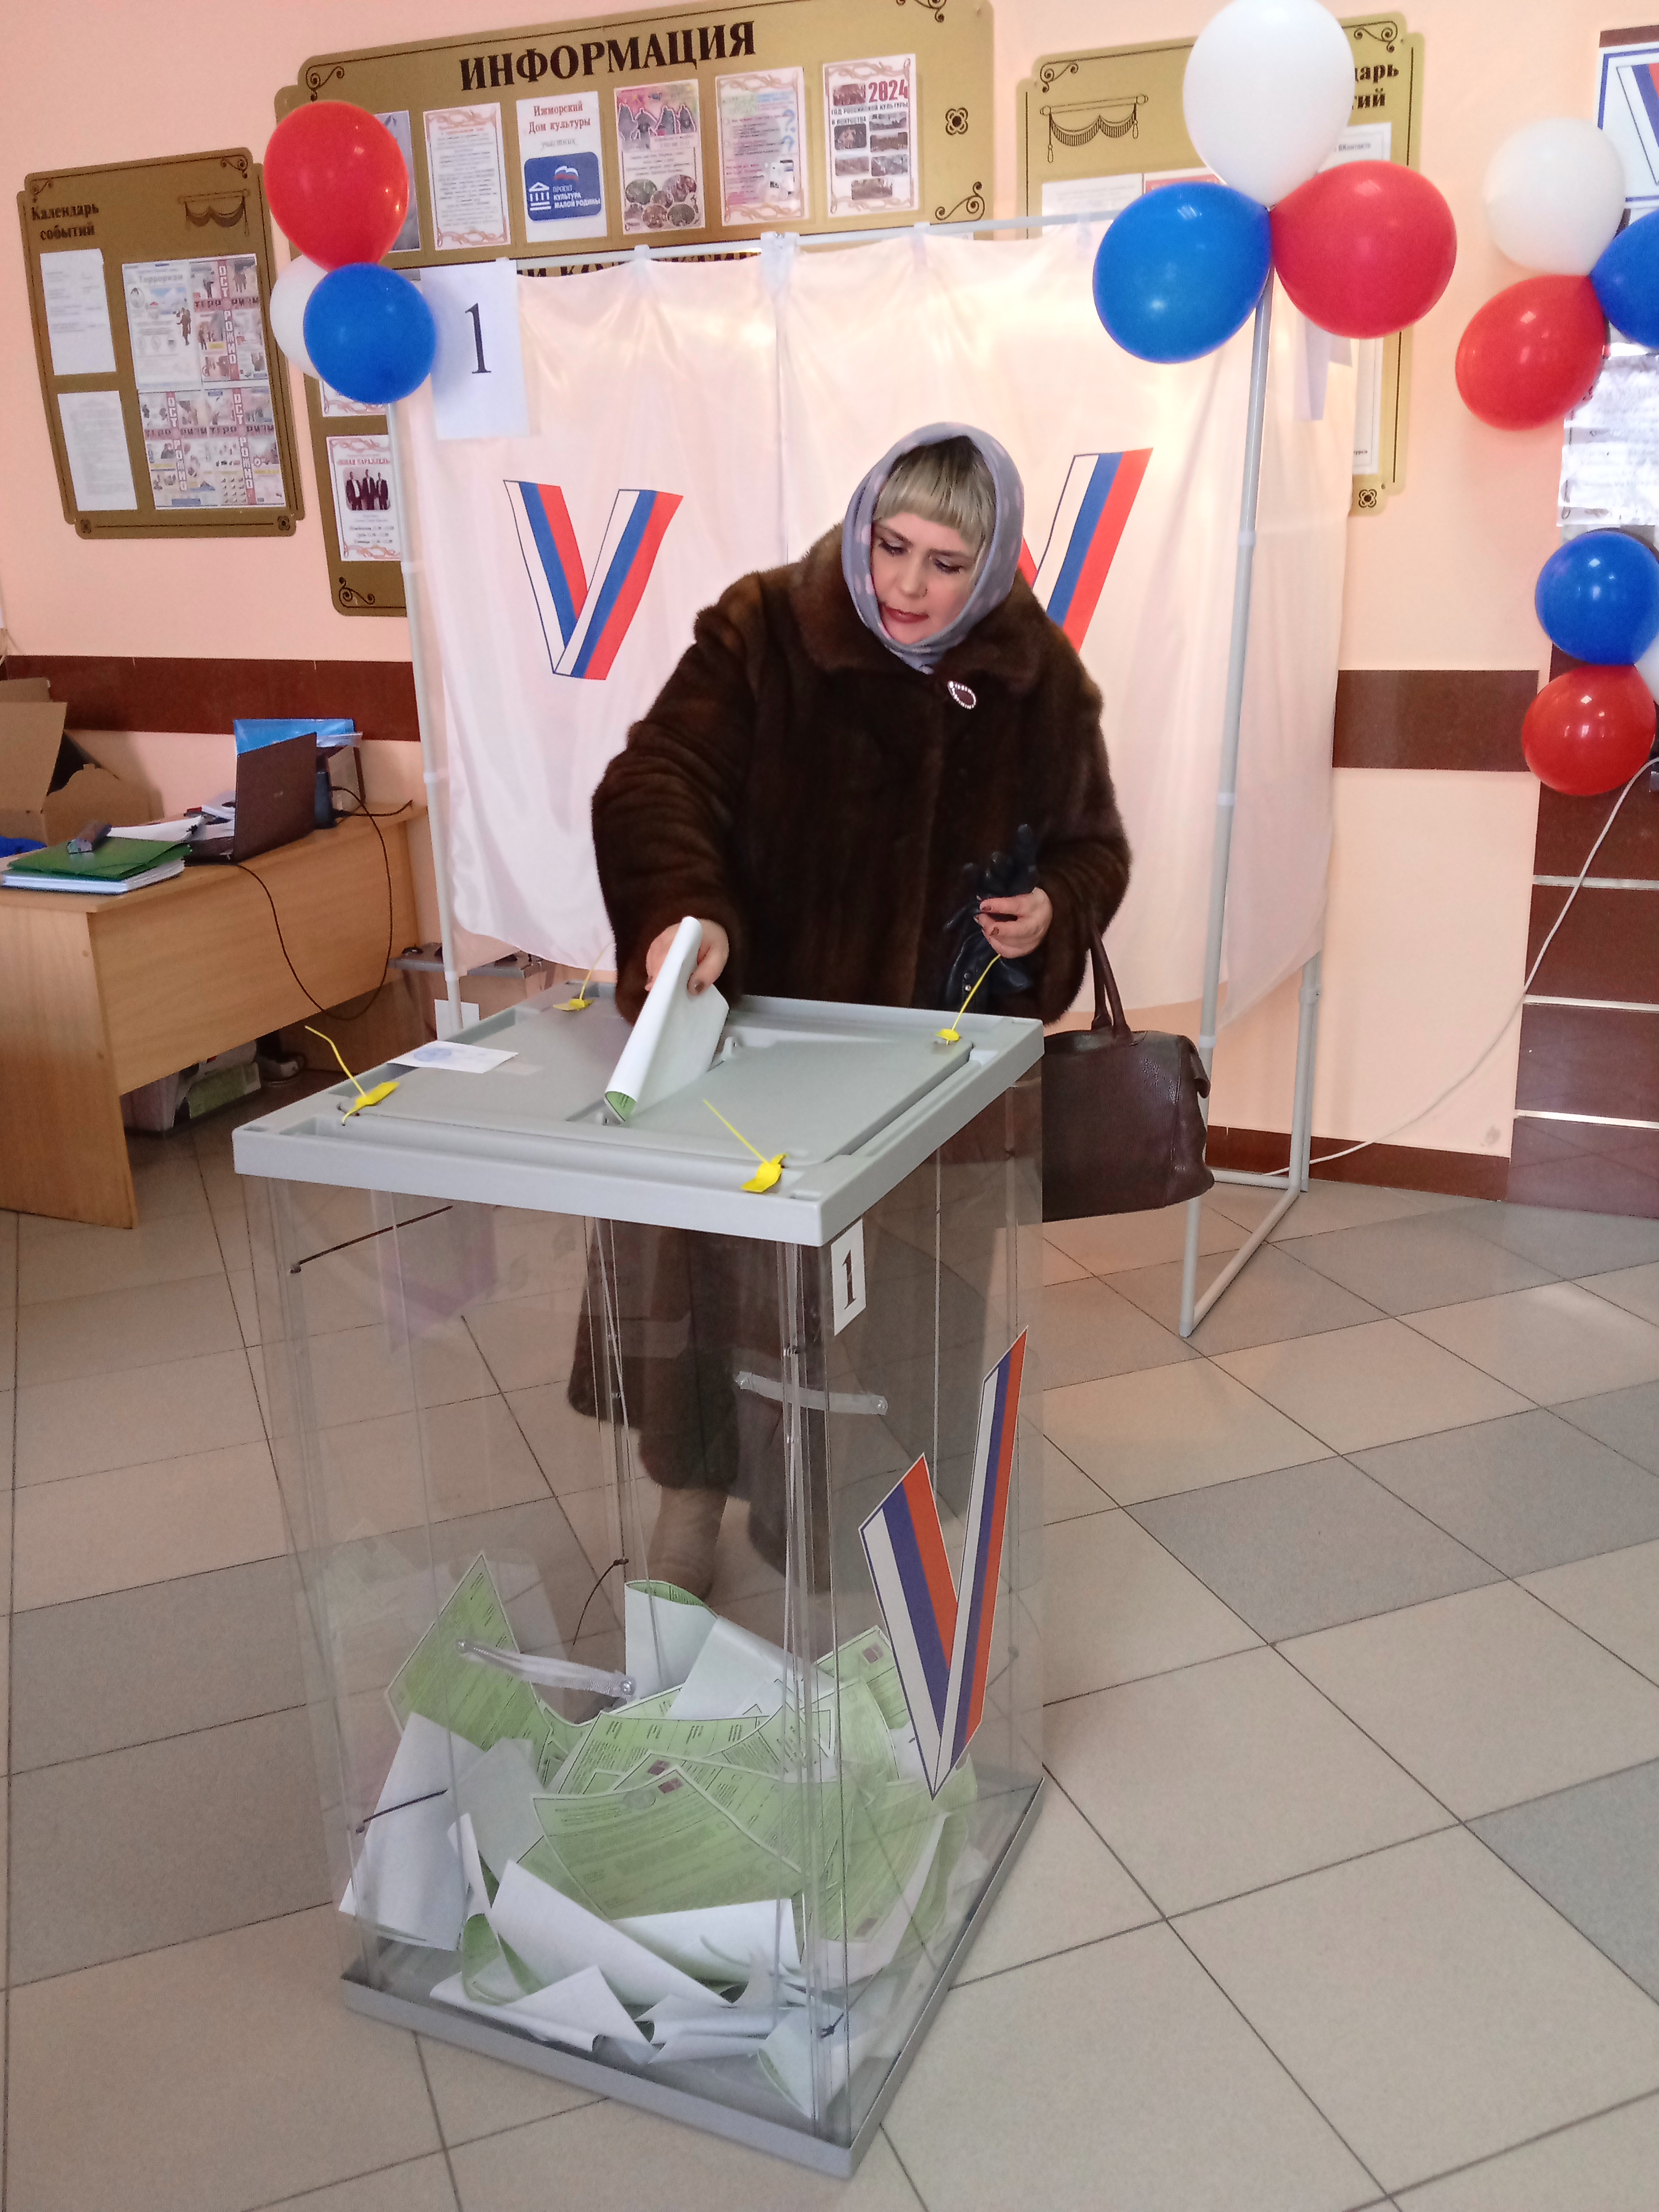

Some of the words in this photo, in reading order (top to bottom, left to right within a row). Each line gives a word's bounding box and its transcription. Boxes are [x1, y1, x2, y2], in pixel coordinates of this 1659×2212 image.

[459, 21, 755, 91] ИНФОРМАЦИЯ
[868, 79, 909, 103] 2024
[534, 101, 583, 116] Ижморский
[529, 121, 546, 134] Дом
[550, 118, 590, 132] культуры
[553, 192, 581, 201] КУЛЬТУРА
[554, 199, 575, 209] МАЛОЙ
[576, 198, 601, 207] РОДИНЫ
[32, 204, 99, 220] Календарь
[40, 221, 95, 240] событий
[465, 302, 491, 373] 1
[842, 1249, 856, 1310] 1
